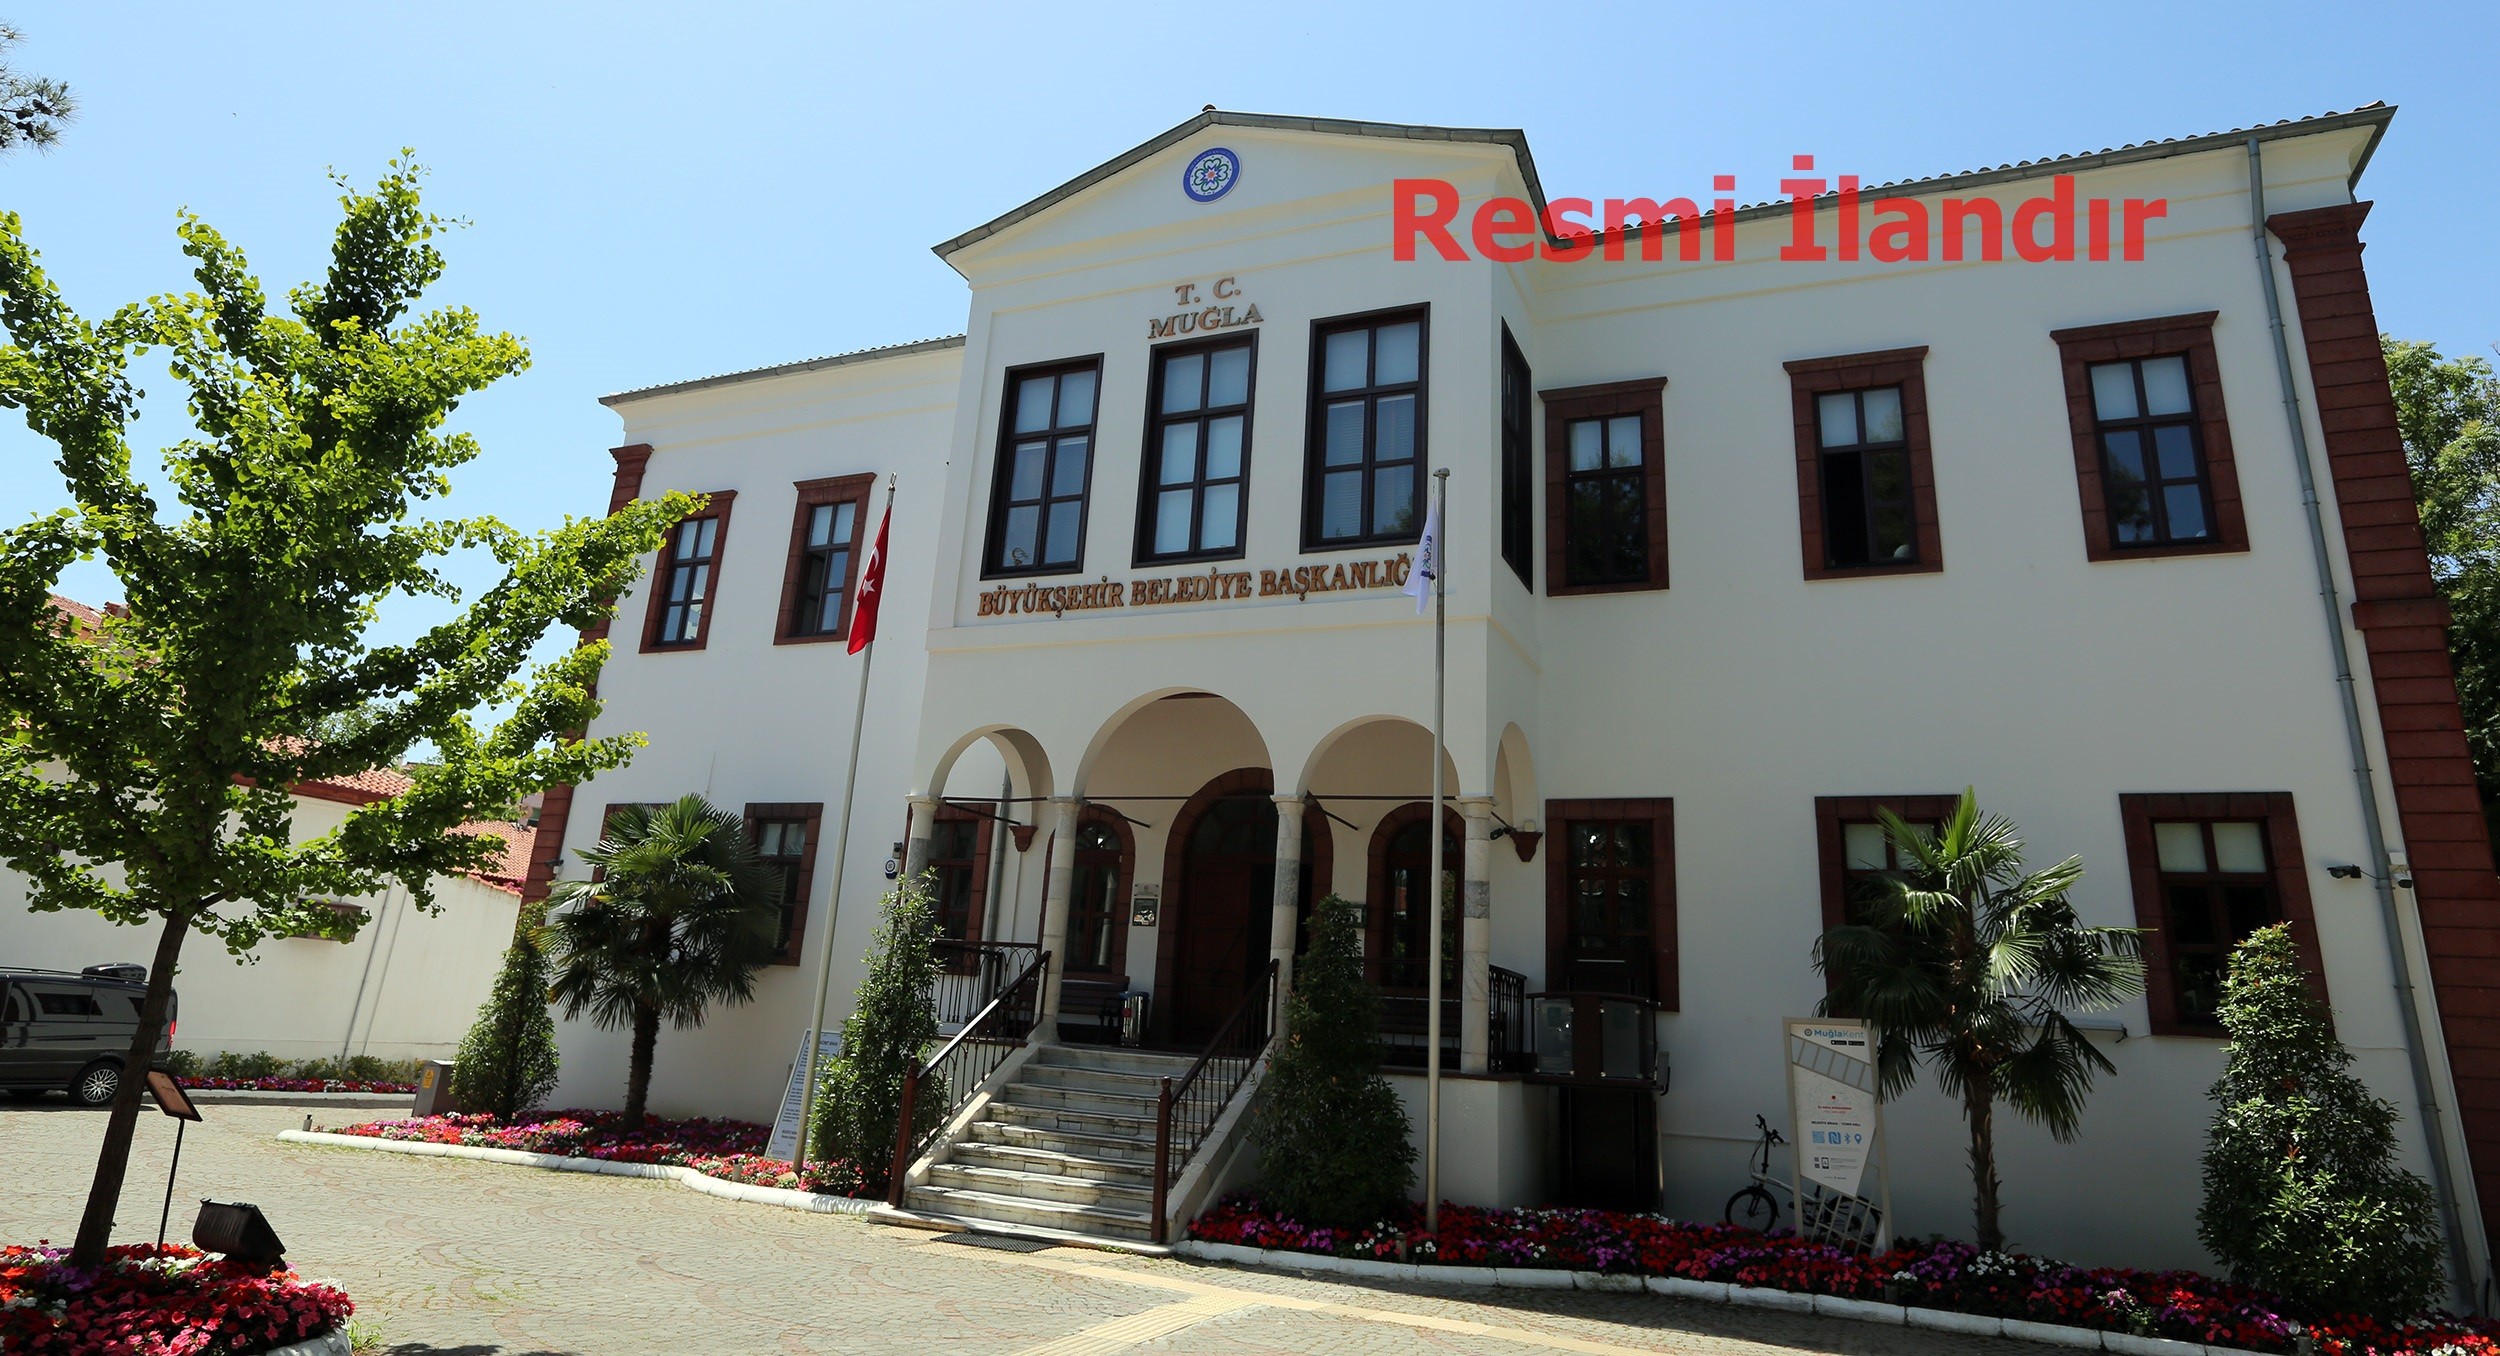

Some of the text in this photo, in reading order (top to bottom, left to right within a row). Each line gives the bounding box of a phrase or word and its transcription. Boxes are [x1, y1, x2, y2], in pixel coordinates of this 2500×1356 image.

[1174, 276, 1242, 306] T. C.
[1147, 302, 1264, 339] MUĞLA
[977, 552, 1414, 619] BÜYÜKŞEHİR BELEDİYE BAŞKANLIĞ
